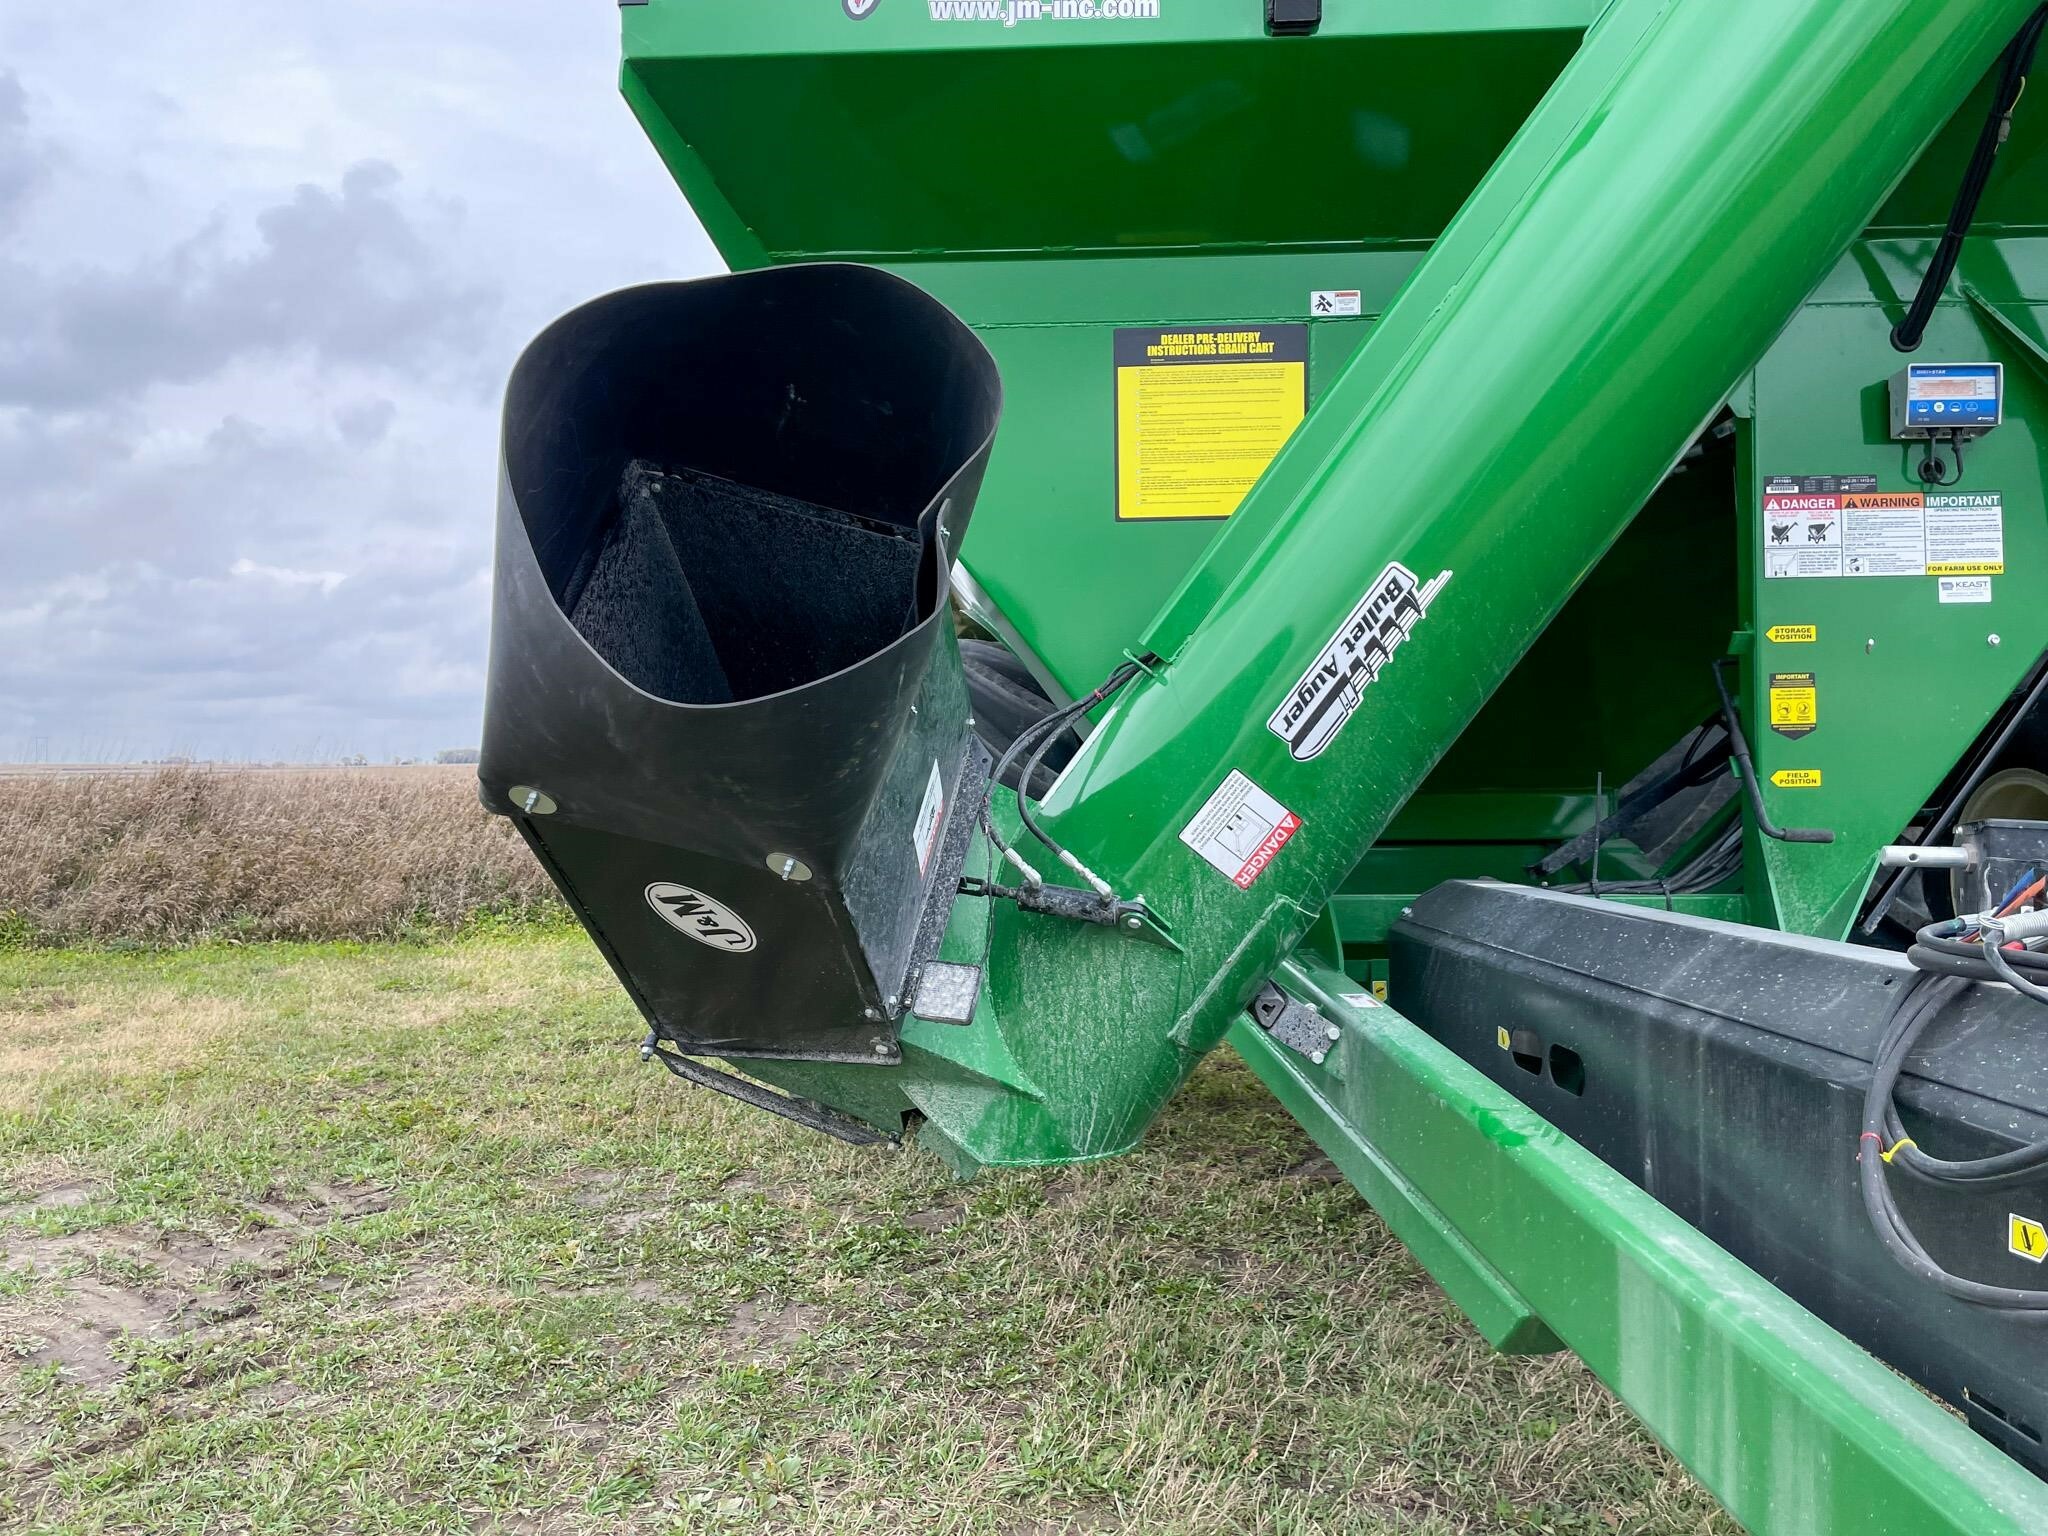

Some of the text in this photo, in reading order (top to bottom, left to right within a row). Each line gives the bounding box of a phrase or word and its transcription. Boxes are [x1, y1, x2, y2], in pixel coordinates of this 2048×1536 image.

[930, 0, 1160, 27] www.jm-inc.com
[1161, 332, 1260, 345] DEALER PRE-DELIVERY
[1147, 342, 1274, 356] INSTRUCTIONS GRAIN CART
[1781, 498, 1836, 510] DANGER
[1860, 497, 1920, 508] WARNING
[1926, 495, 2000, 507] IMPORTANT
[1282, 576, 1404, 733] Bullet Auger
[1235, 827, 1288, 885] DANGER
[655, 894, 747, 946] J&M
